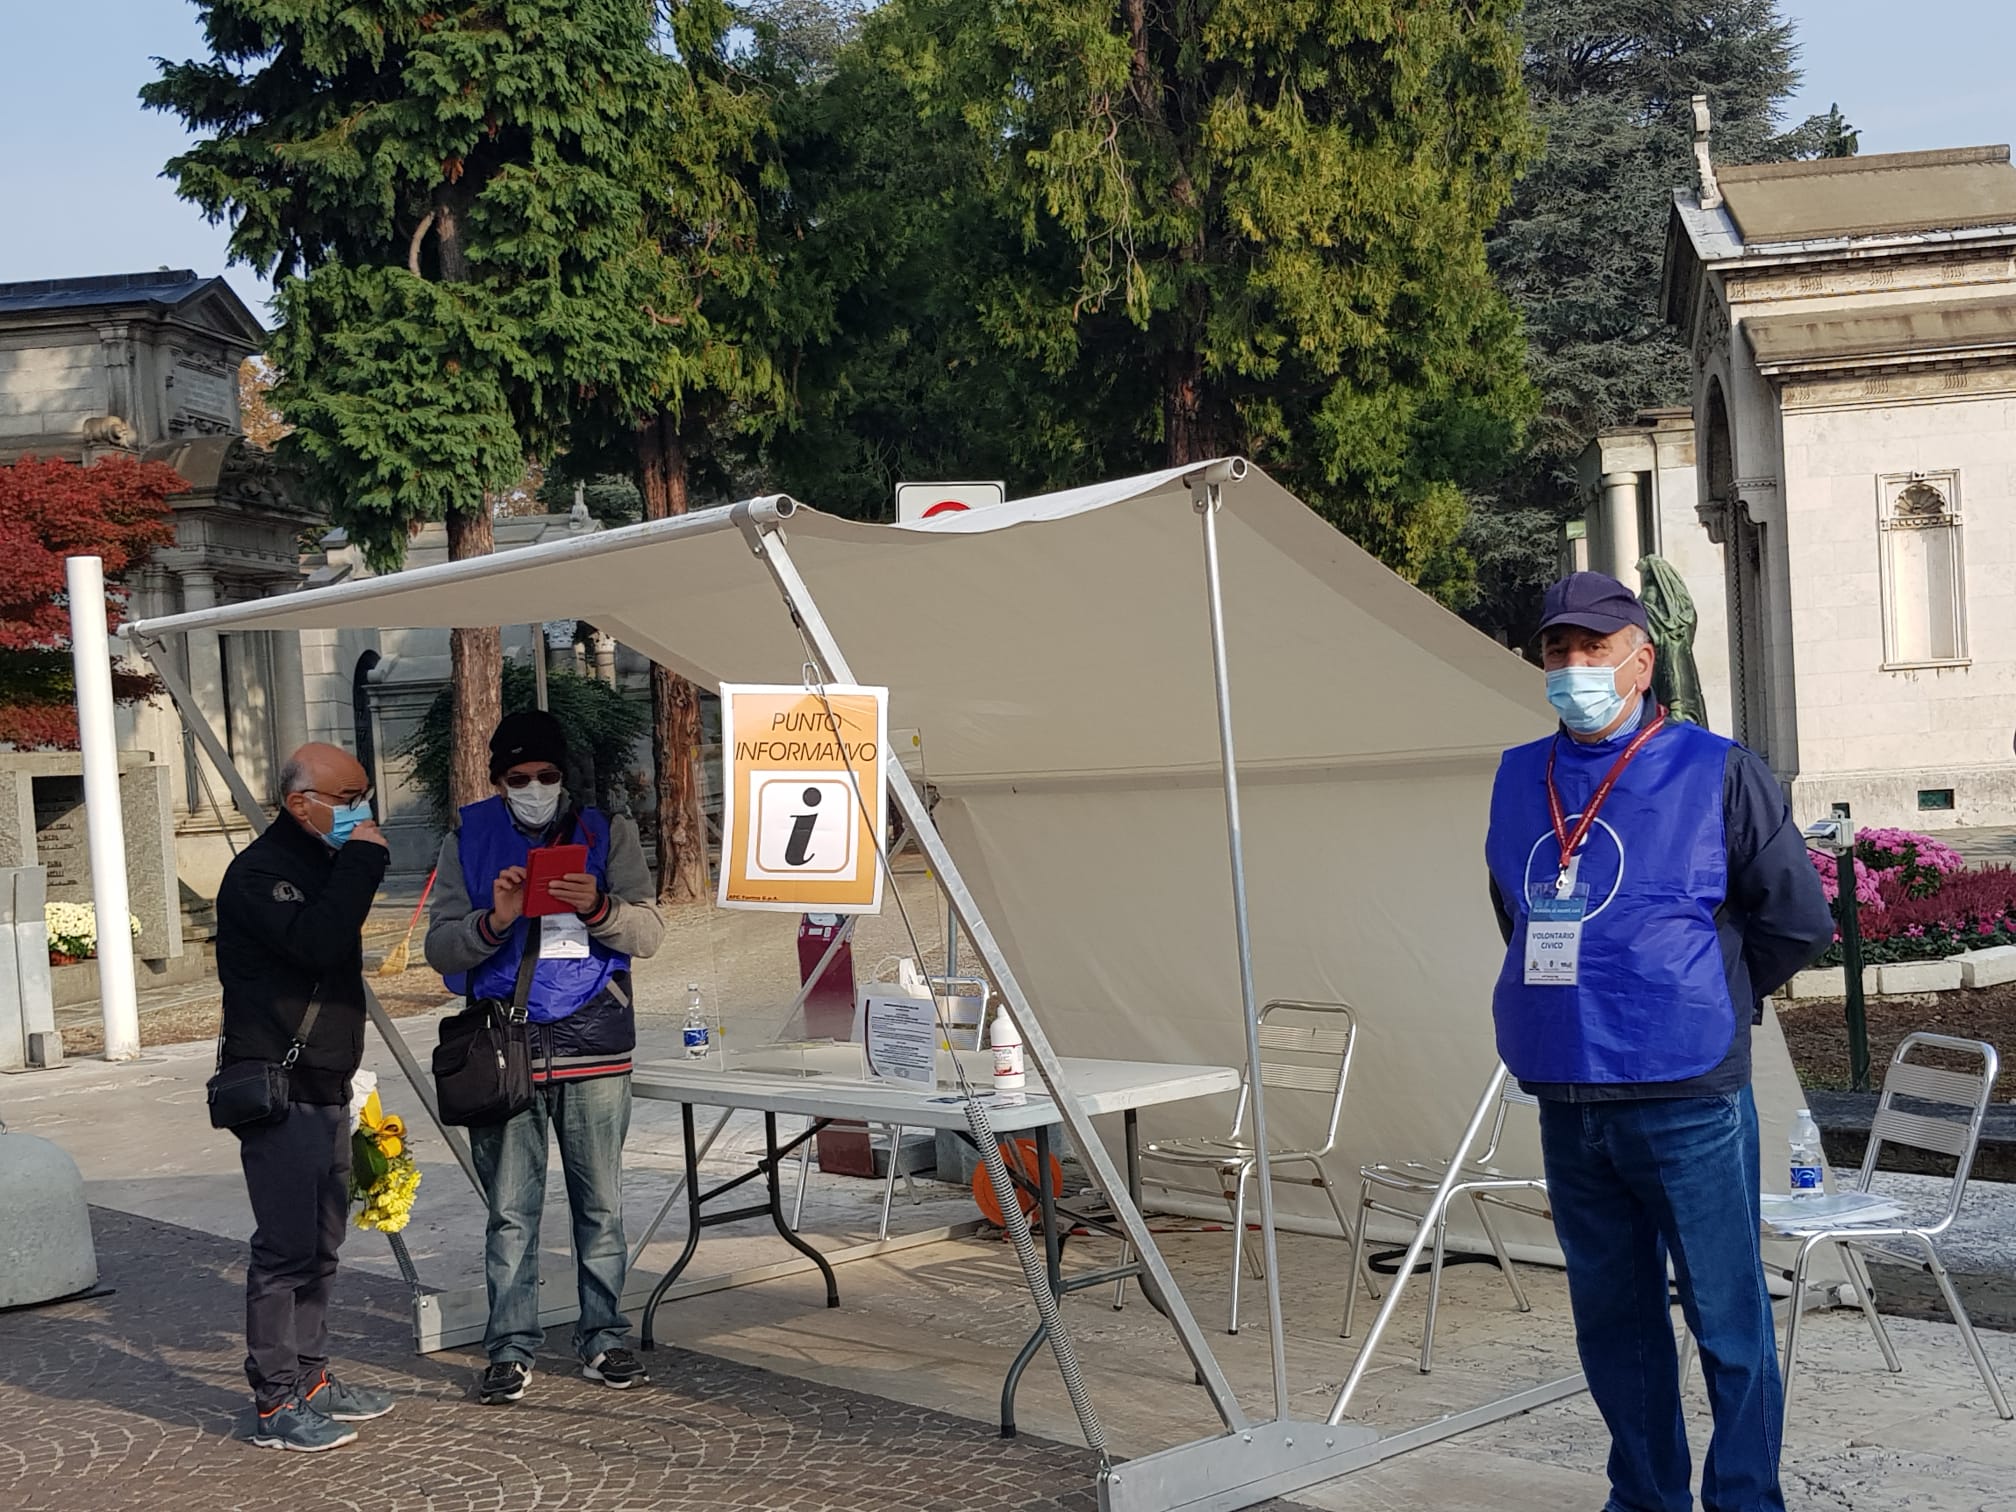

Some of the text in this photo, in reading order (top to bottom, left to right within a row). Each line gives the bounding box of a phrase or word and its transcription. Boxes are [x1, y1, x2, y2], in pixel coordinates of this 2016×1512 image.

[772, 712, 842, 732] PUNTO
[735, 742, 877, 762] INFORMATIVO
[1532, 932, 1575, 940] VOLONTARIO
[1541, 942, 1564, 950] CIVICO
